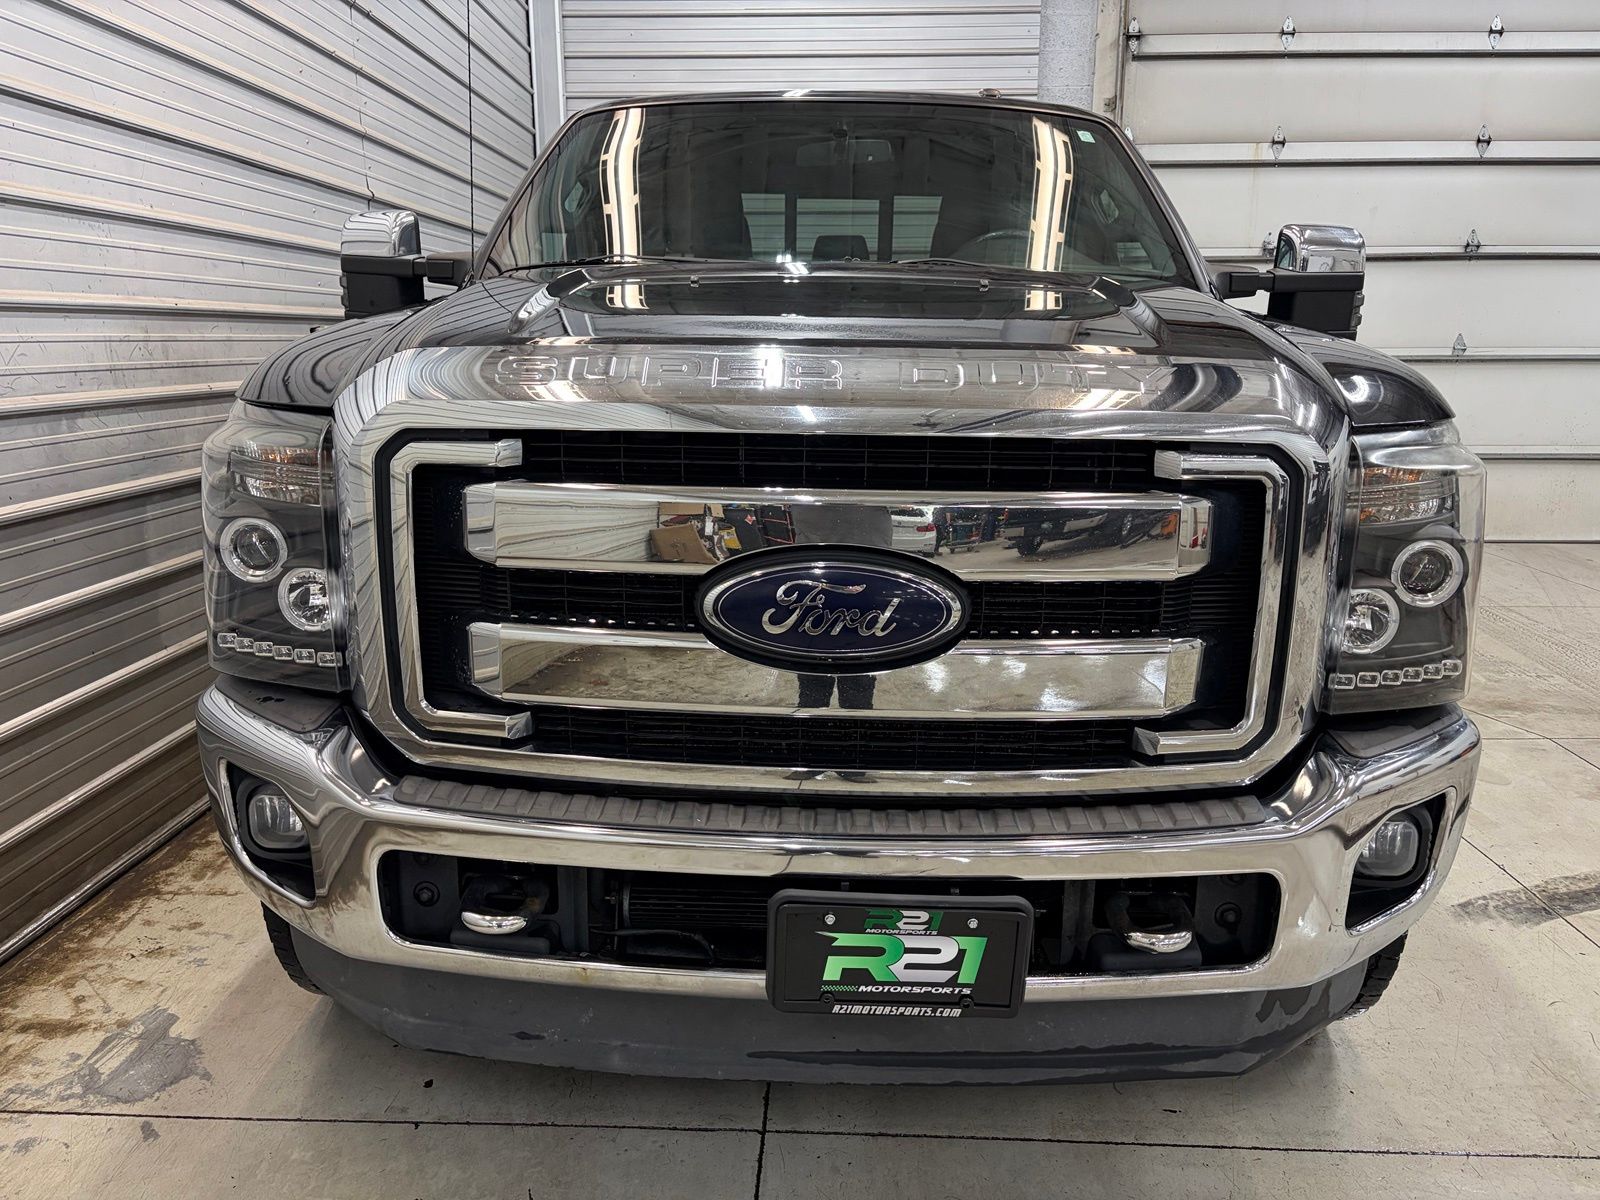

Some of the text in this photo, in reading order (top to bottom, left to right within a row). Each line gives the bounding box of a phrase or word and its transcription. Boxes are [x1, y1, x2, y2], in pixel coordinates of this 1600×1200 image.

[494, 355, 1178, 394] SUPER DUTY
[761, 579, 901, 637] Ford
[863, 908, 943, 929] R21
[815, 931, 988, 984] R21
[857, 985, 973, 995] MOTORSPORTS
[831, 1004, 962, 1018] R21MOTORSPORTS.COM
